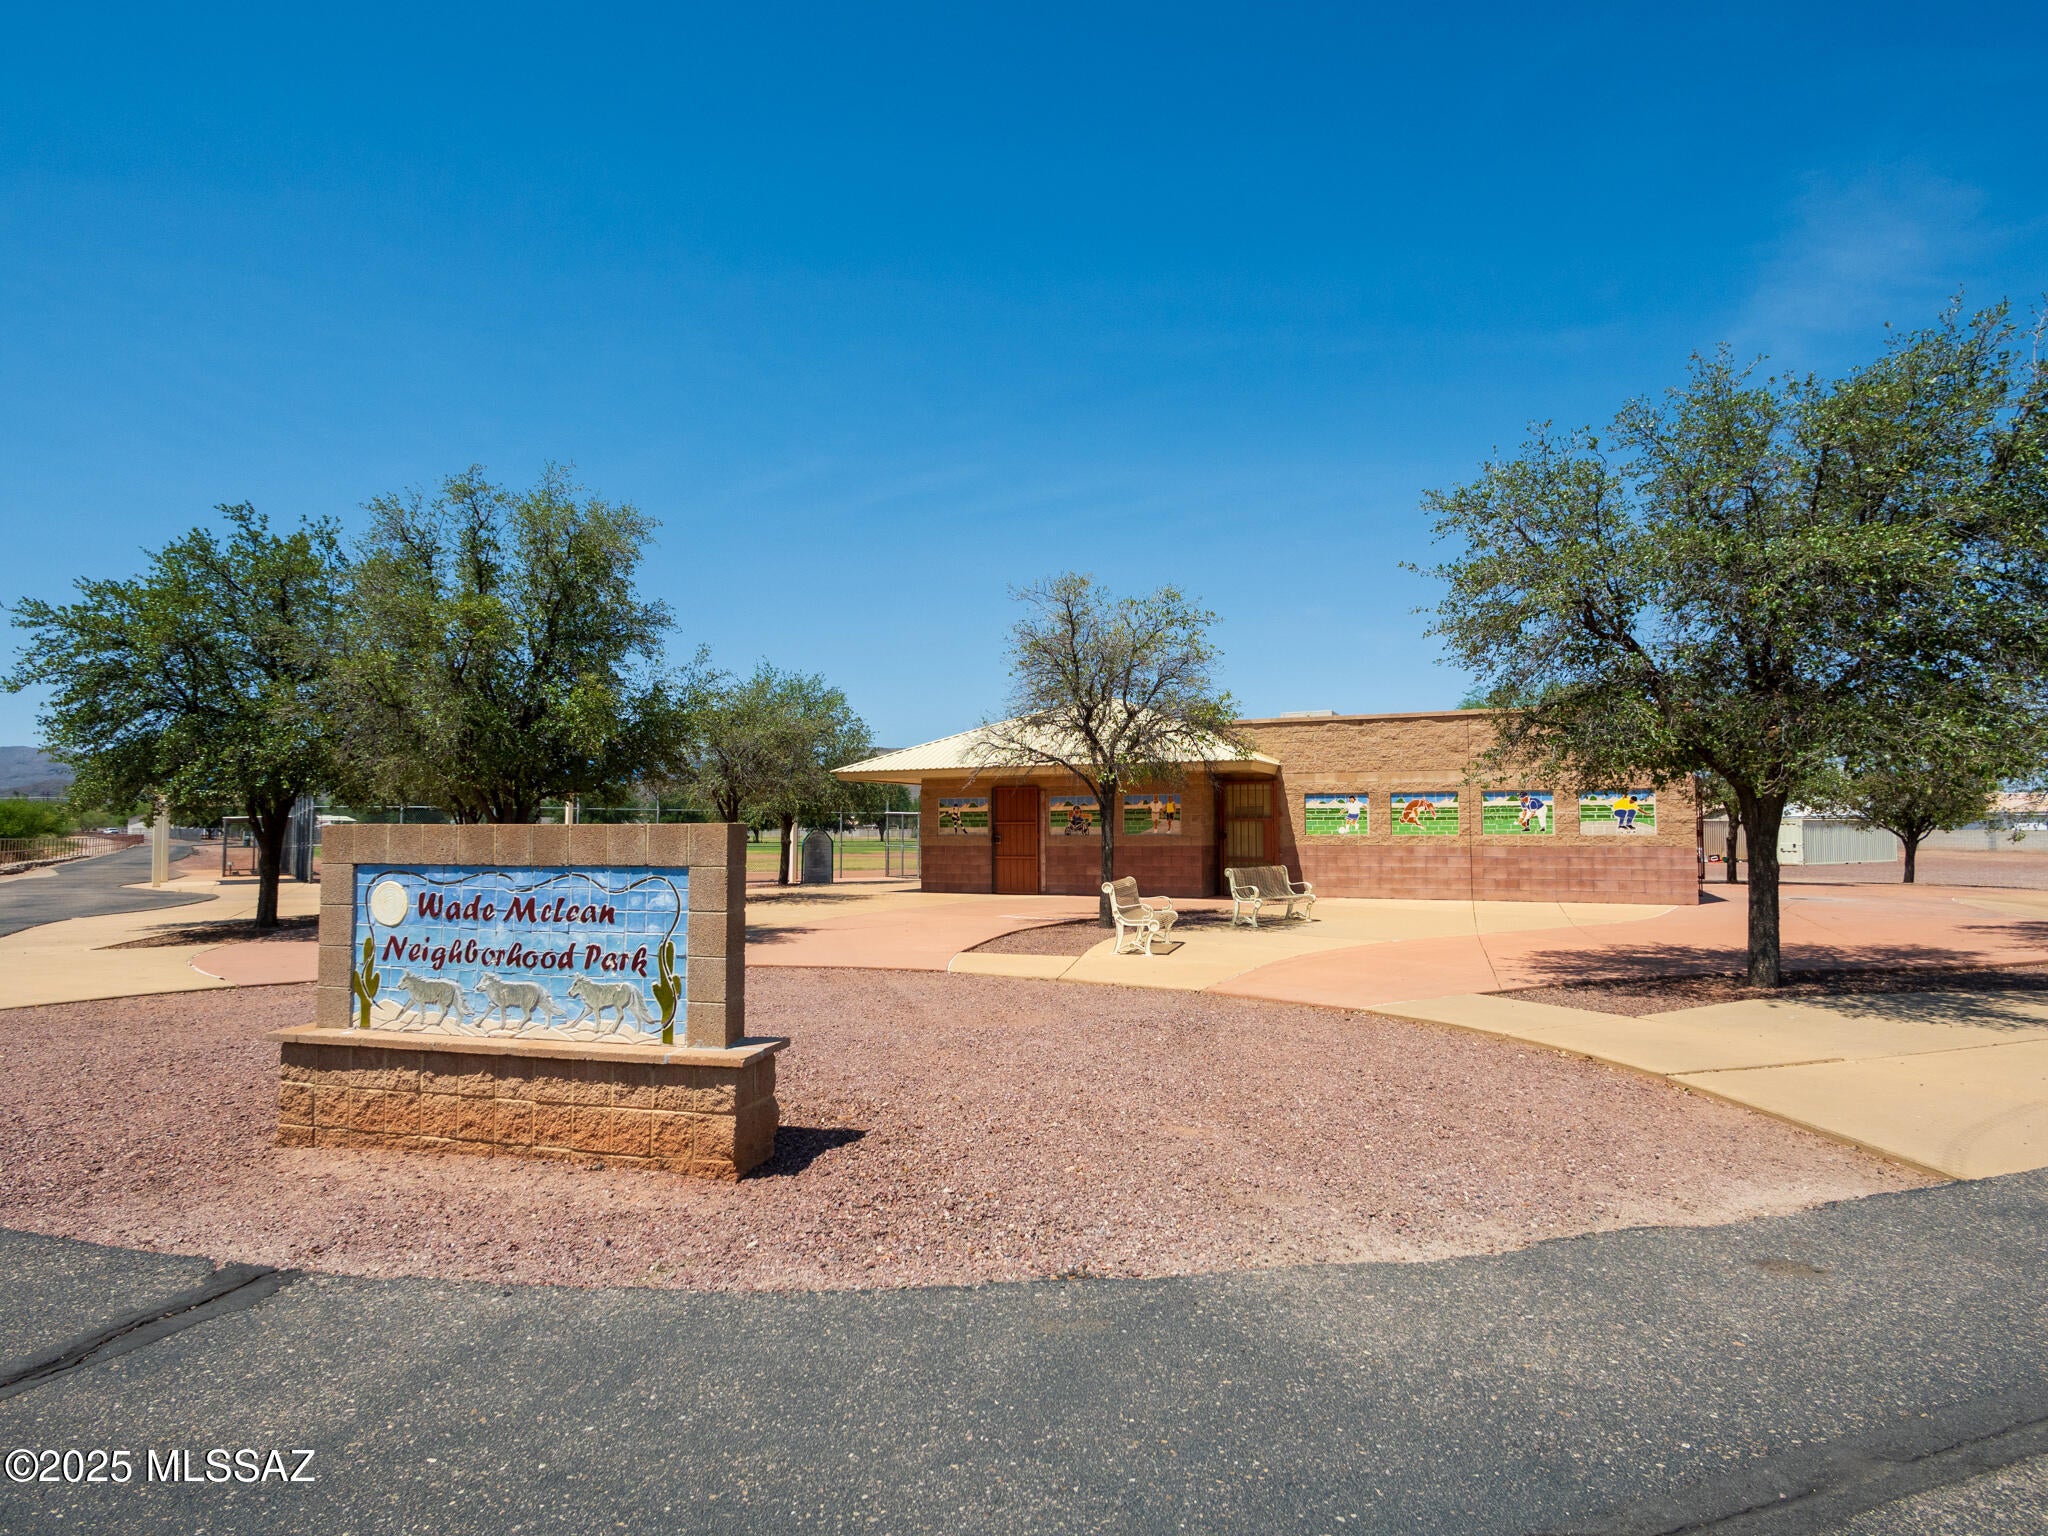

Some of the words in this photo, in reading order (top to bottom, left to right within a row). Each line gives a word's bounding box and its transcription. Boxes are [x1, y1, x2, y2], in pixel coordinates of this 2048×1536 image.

[418, 892, 495, 922] Wade
[503, 896, 616, 924] McLean
[382, 935, 576, 970] Neighborhood
[584, 943, 648, 978] Park
